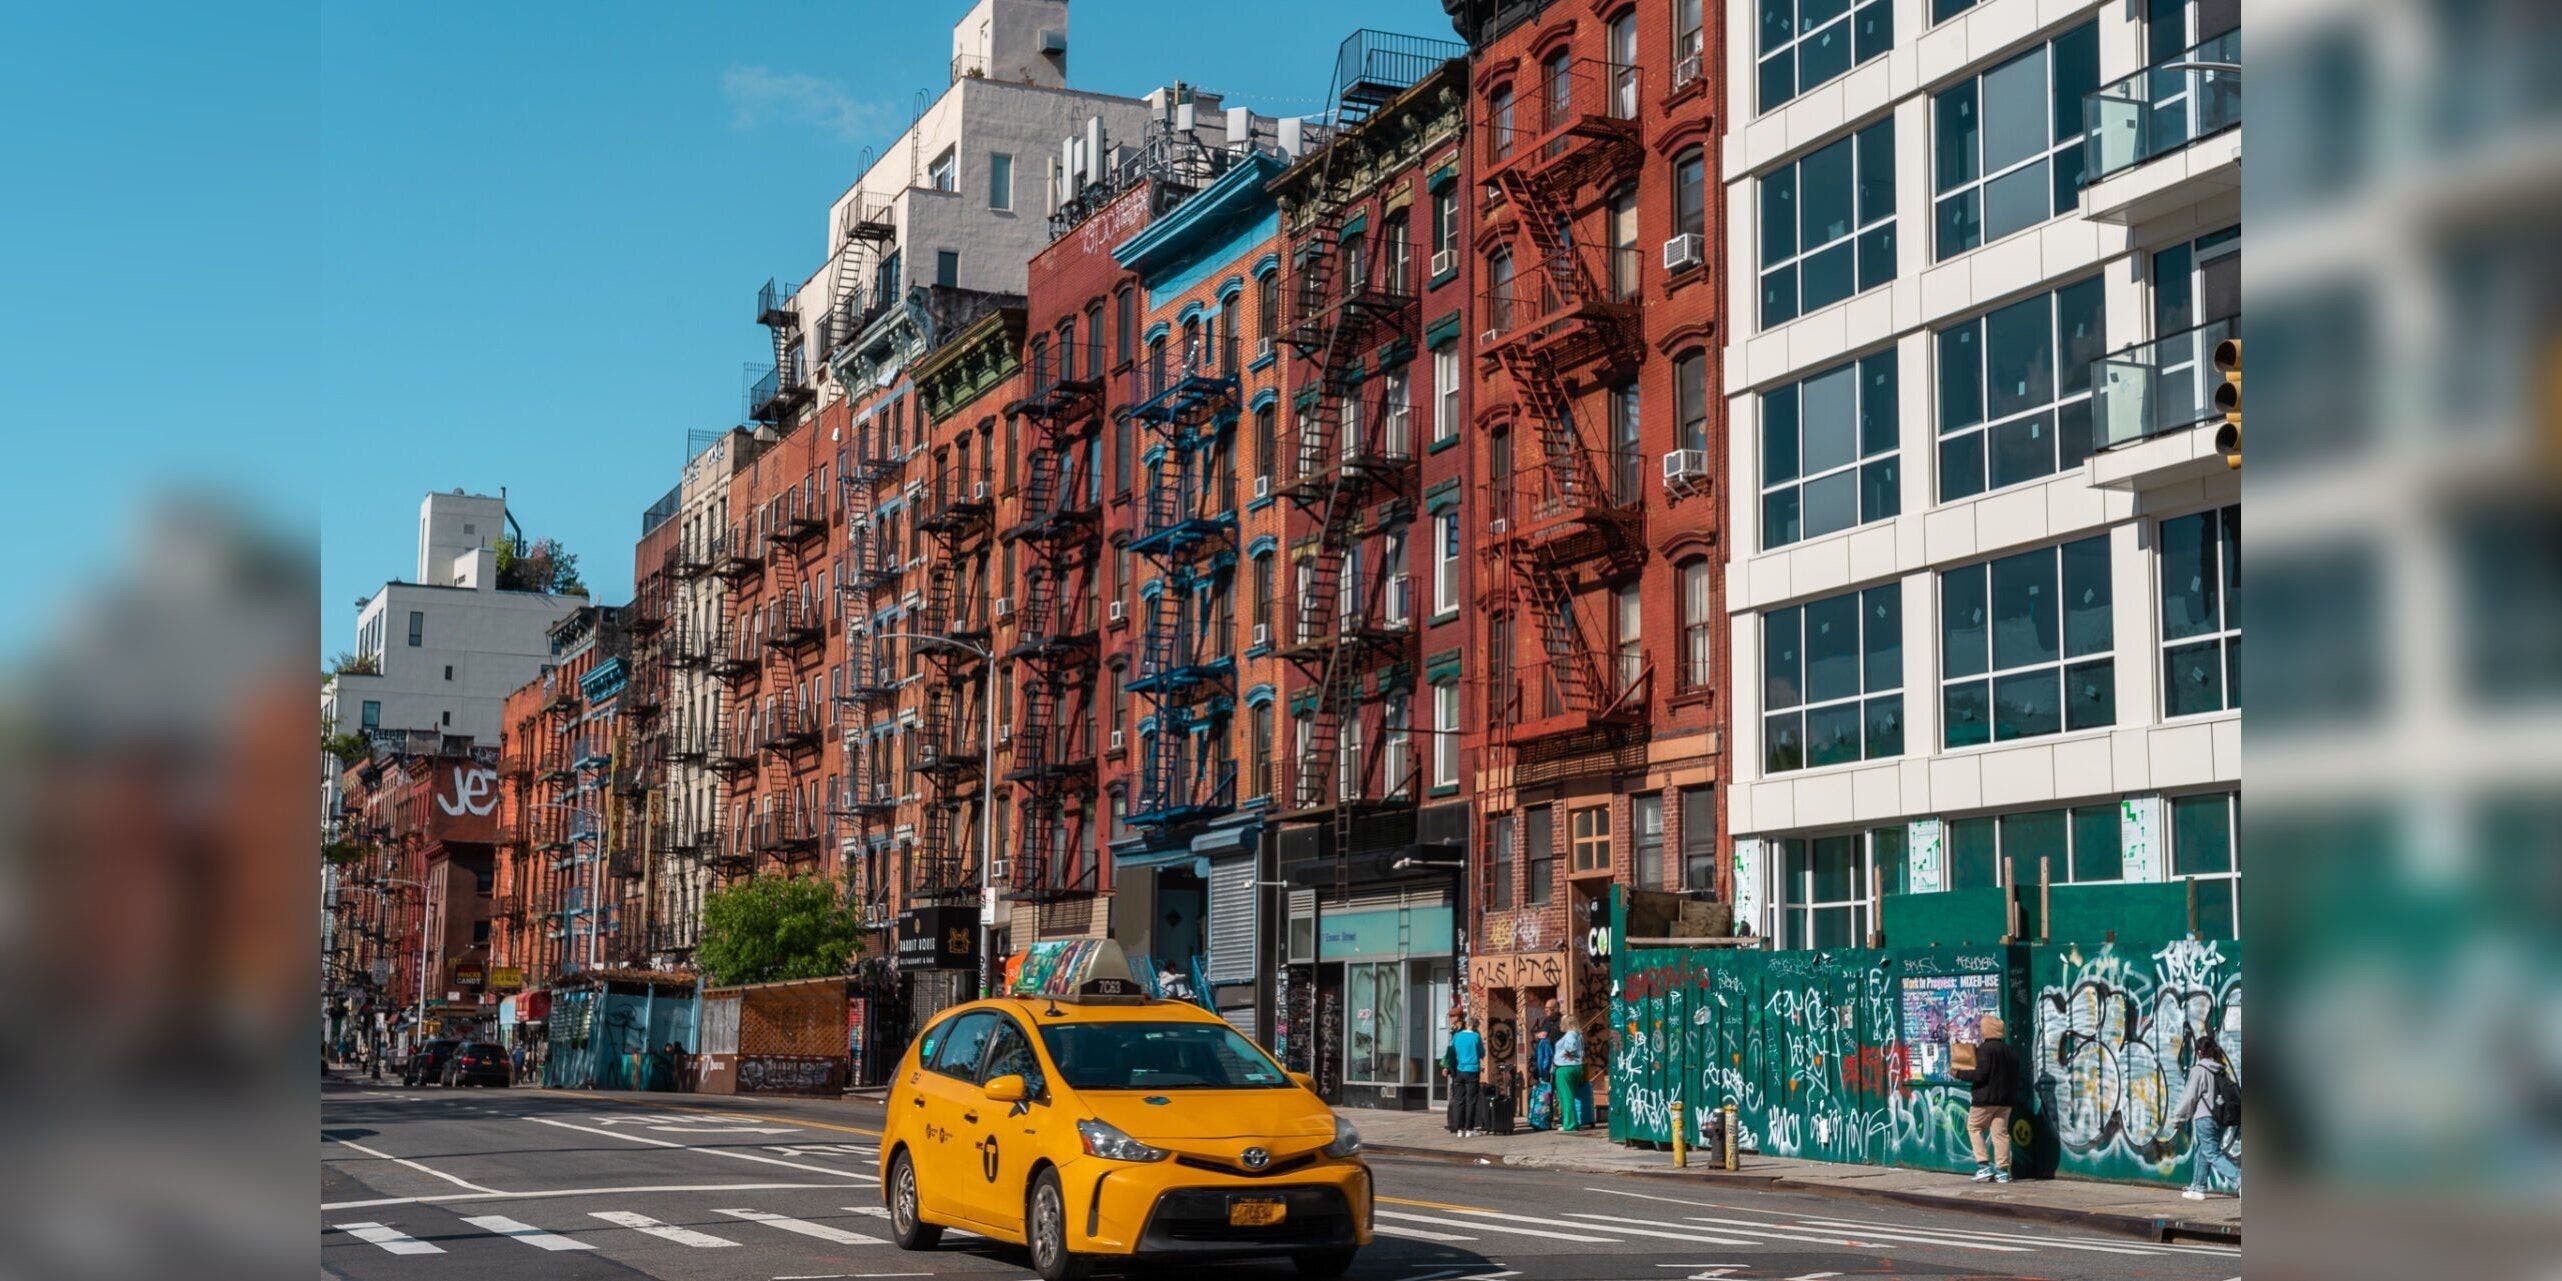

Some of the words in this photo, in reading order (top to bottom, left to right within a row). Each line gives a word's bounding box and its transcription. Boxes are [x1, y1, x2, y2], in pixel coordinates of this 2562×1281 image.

[1588, 927, 1611, 956] CO
[1903, 978, 1918, 989] Work
[1960, 974, 1999, 988] MIXED-USE
